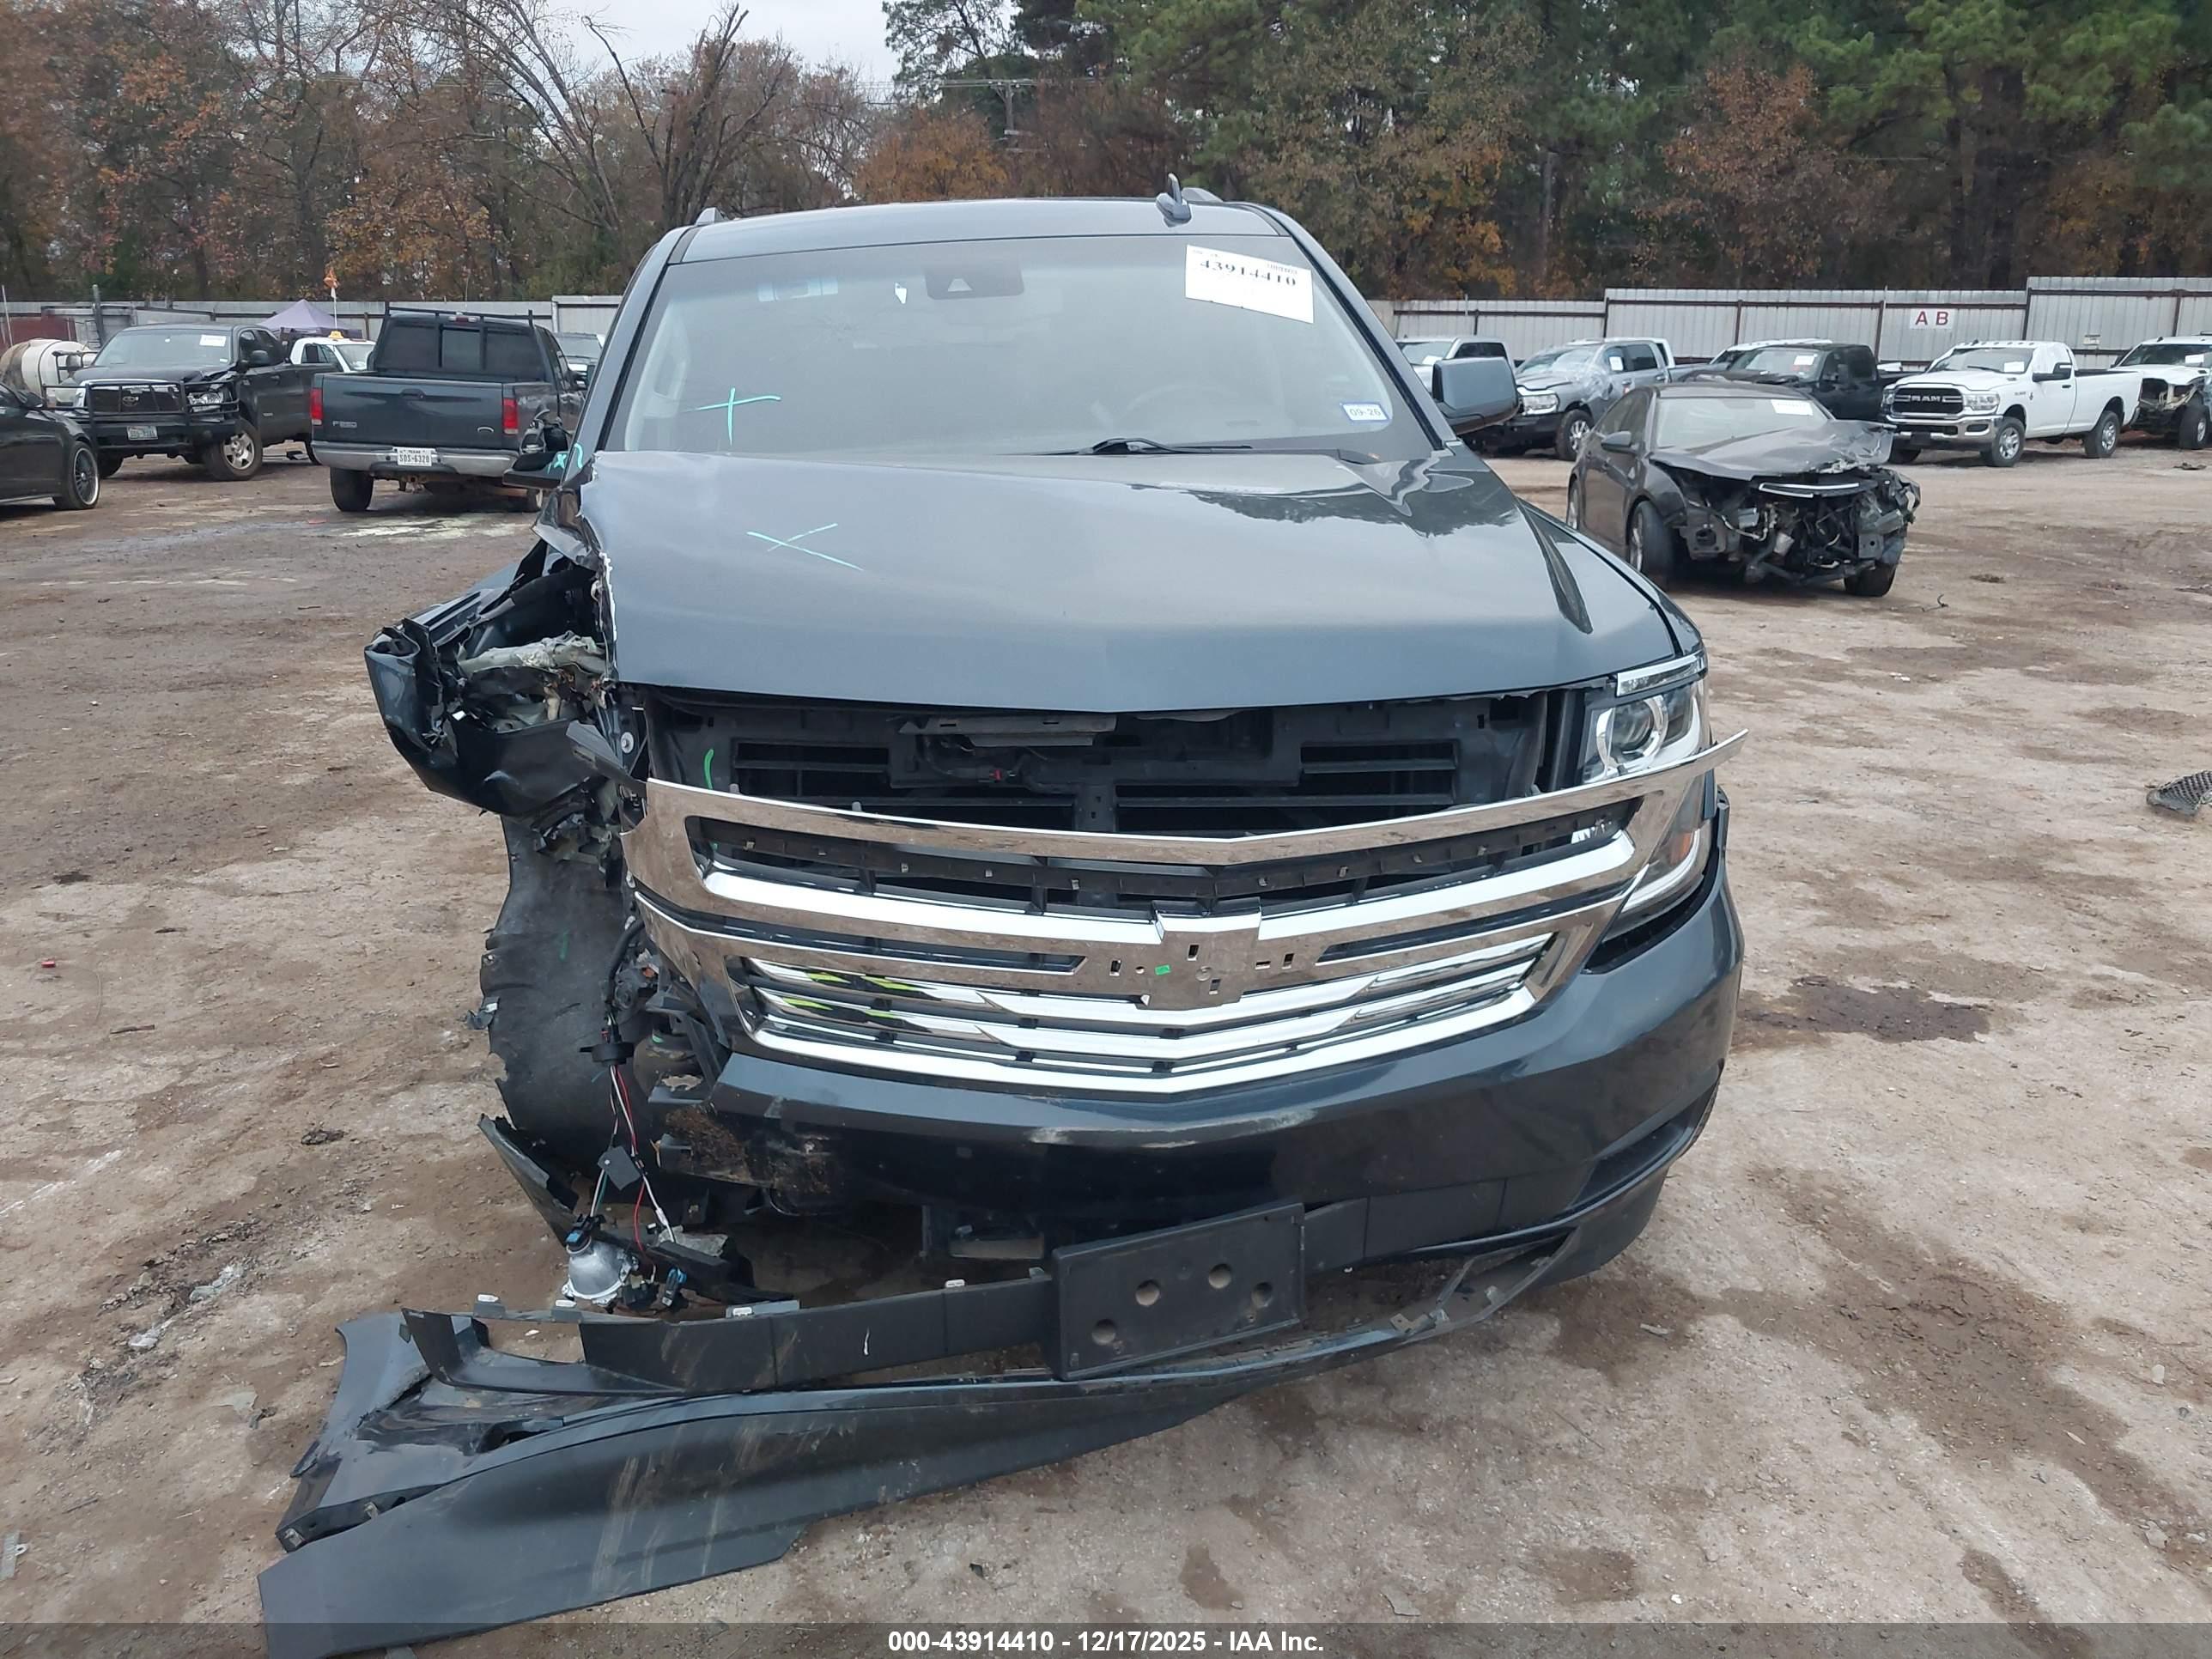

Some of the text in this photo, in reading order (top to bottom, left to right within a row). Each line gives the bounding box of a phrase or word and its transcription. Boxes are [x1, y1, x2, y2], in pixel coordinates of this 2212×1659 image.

[1200, 259, 1297, 287] 43914410
[1915, 311, 1949, 325] A B
